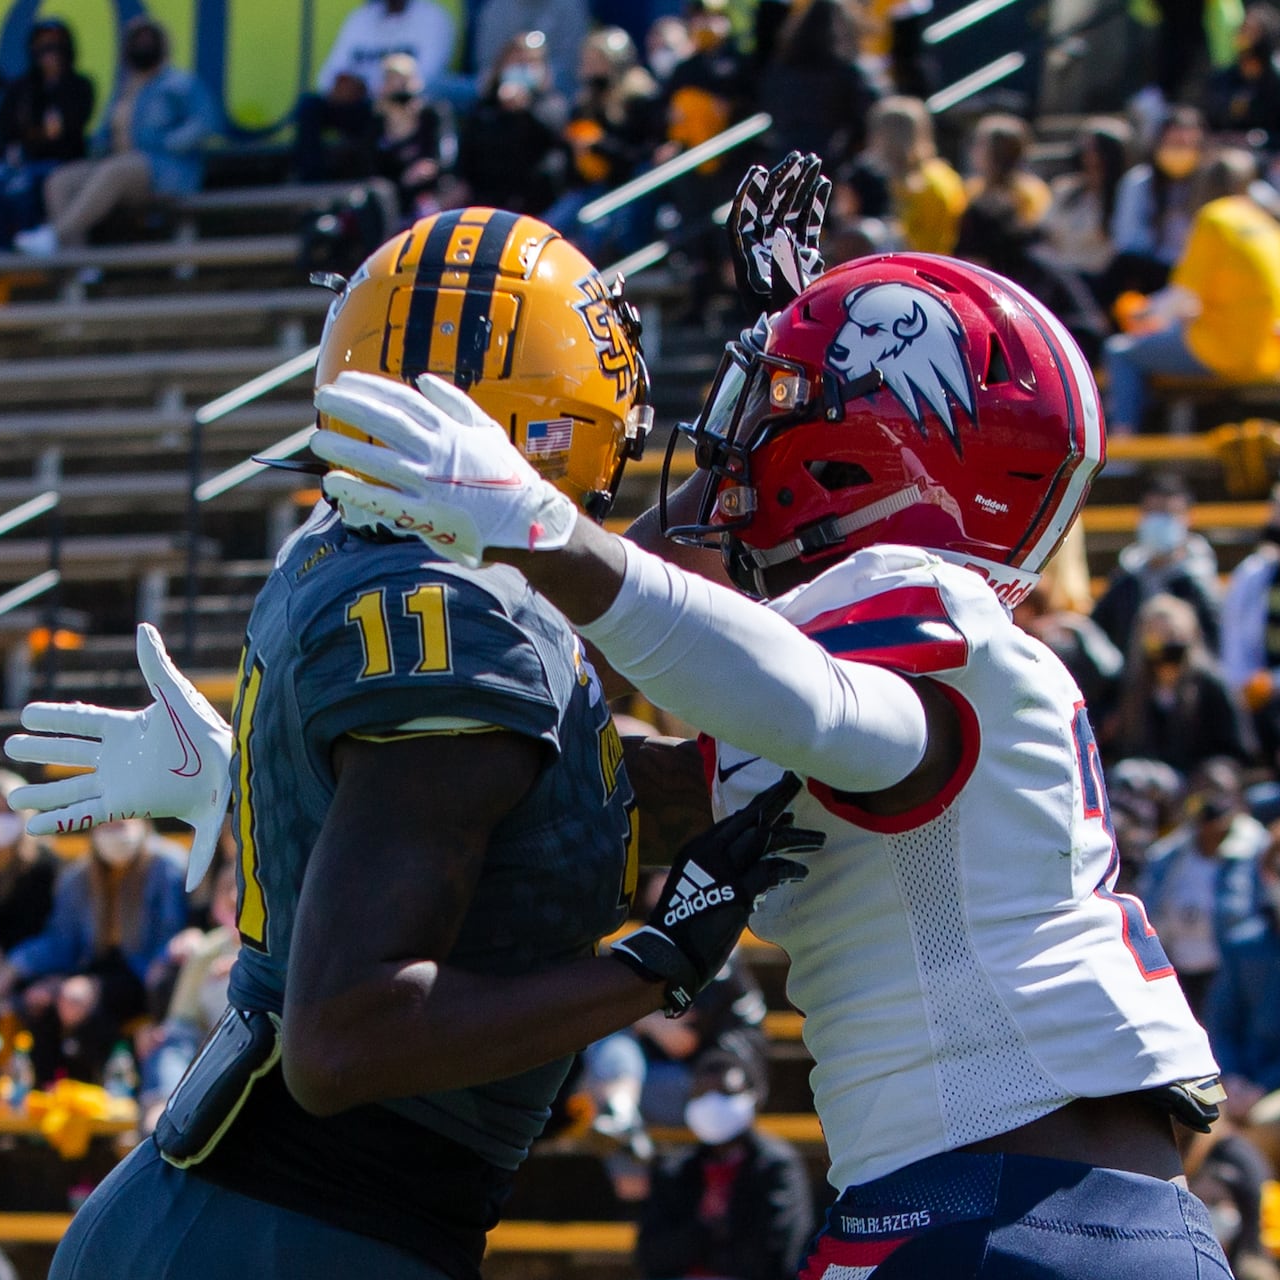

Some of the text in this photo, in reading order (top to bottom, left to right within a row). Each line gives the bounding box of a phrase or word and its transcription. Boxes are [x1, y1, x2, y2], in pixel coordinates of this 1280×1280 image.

[344, 582, 455, 683] 11
[663, 885, 736, 927] adidas
[840, 1209, 930, 1235] TRAILBLAZERS
